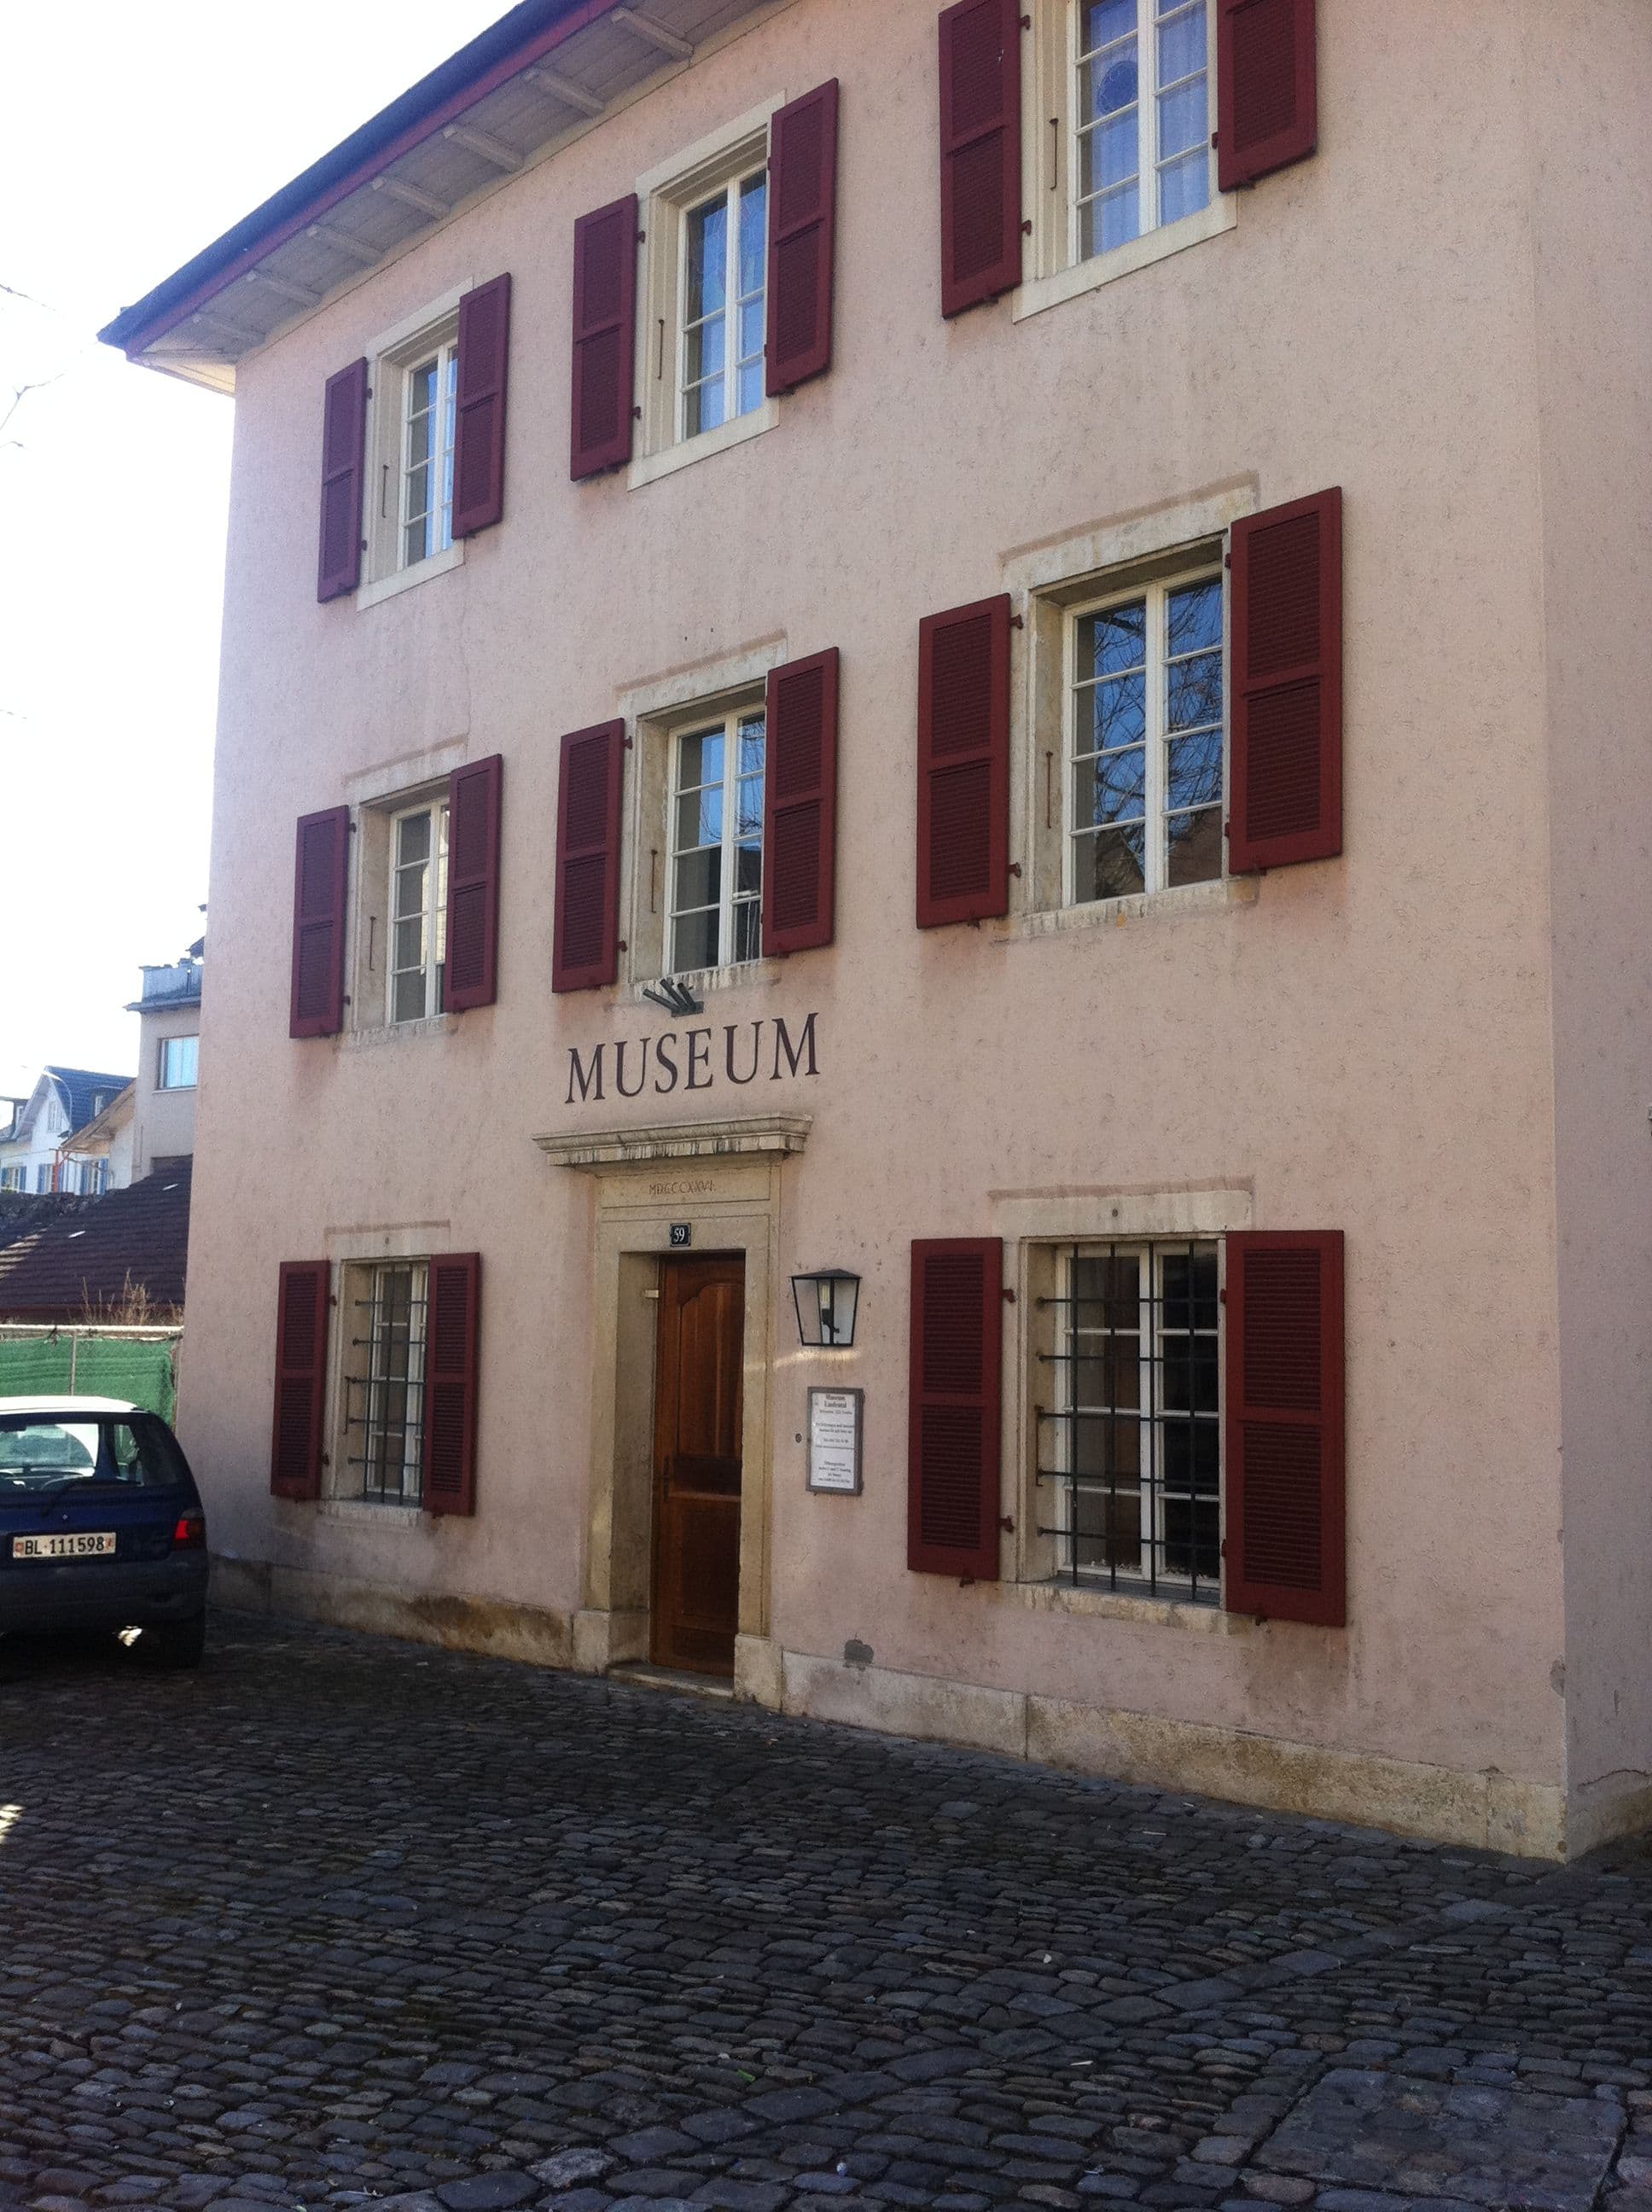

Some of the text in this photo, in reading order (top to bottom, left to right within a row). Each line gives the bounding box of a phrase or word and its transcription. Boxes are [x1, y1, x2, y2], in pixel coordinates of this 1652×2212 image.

[565, 1012, 820, 1103] MUSEUM
[673, 1227, 685, 1243] 59
[25, 1536, 104, 1555] BL 111598
